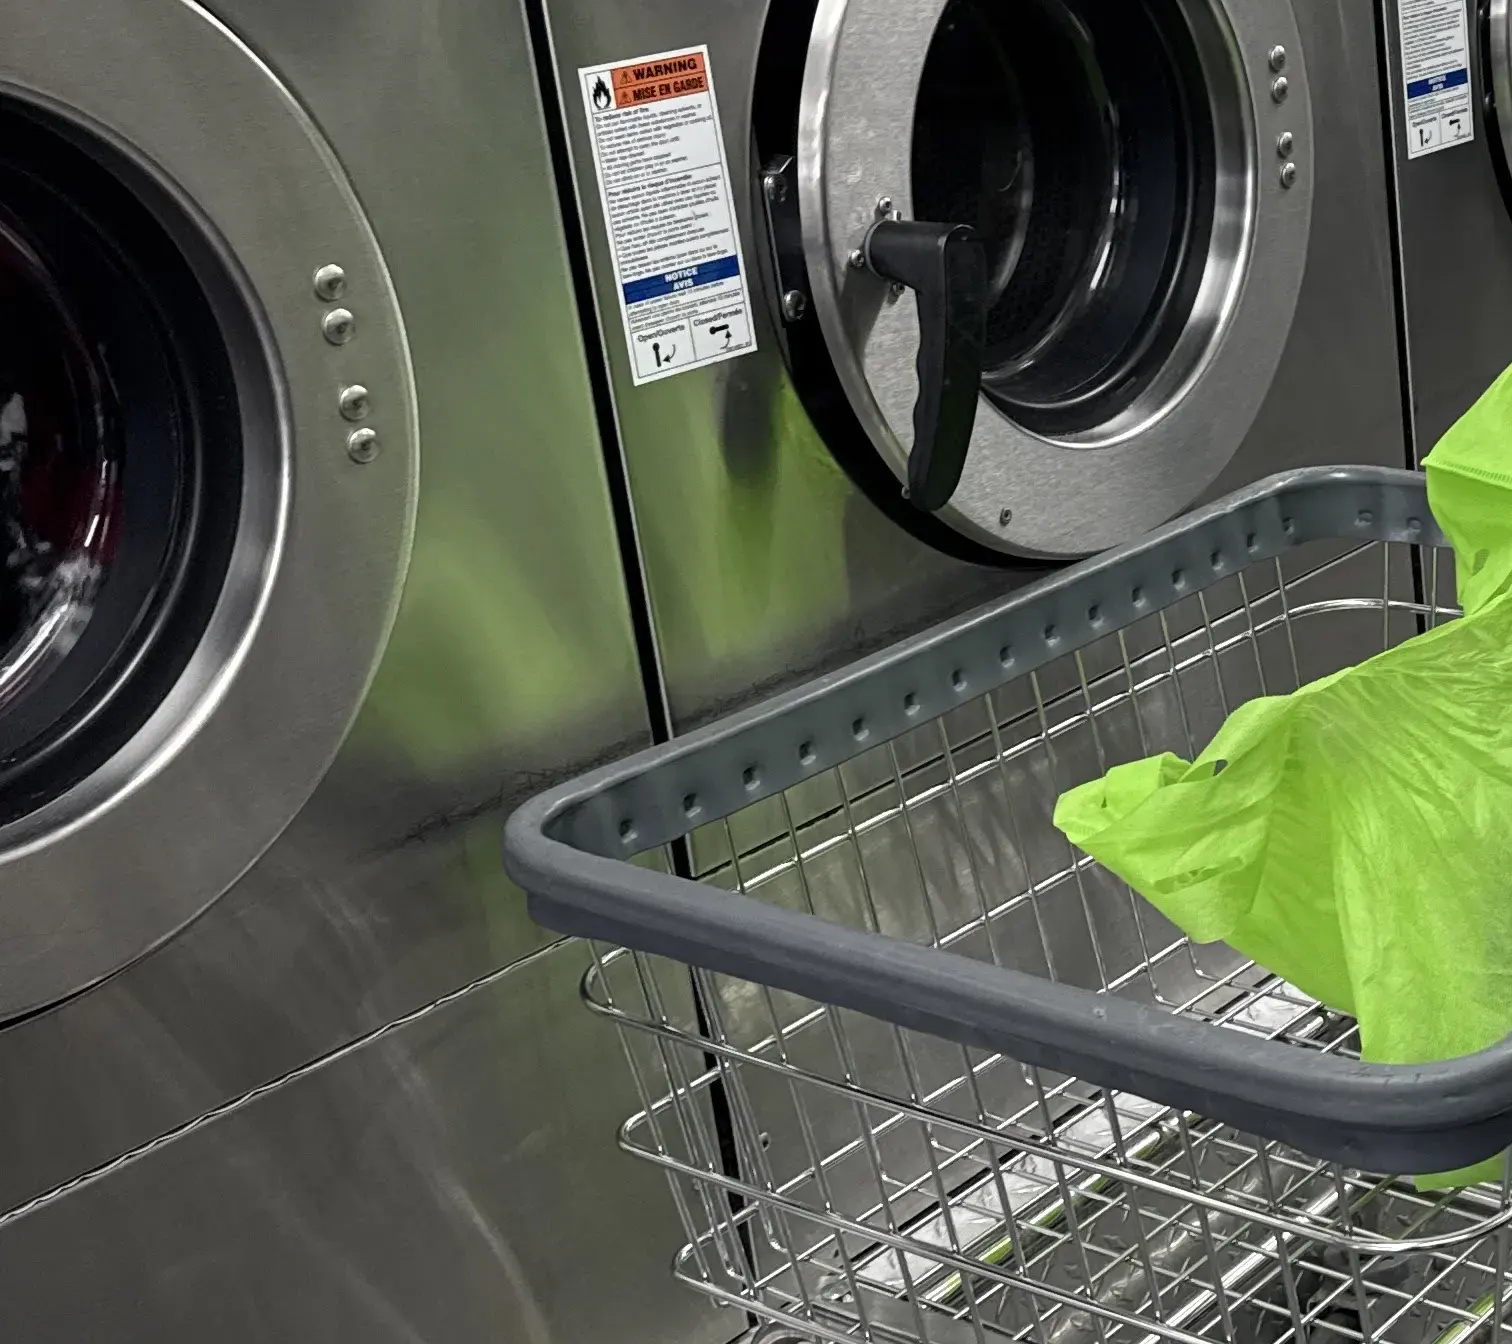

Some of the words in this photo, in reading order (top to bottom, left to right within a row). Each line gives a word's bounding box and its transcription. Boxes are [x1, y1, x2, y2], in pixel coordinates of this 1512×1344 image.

[632, 58, 697, 80] WARNING
[633, 86, 657, 102] MISE
[659, 84, 671, 96] EN
[673, 76, 705, 93] GARDE
[664, 266, 698, 283] NOTICE
[672, 278, 694, 291] AVIS
